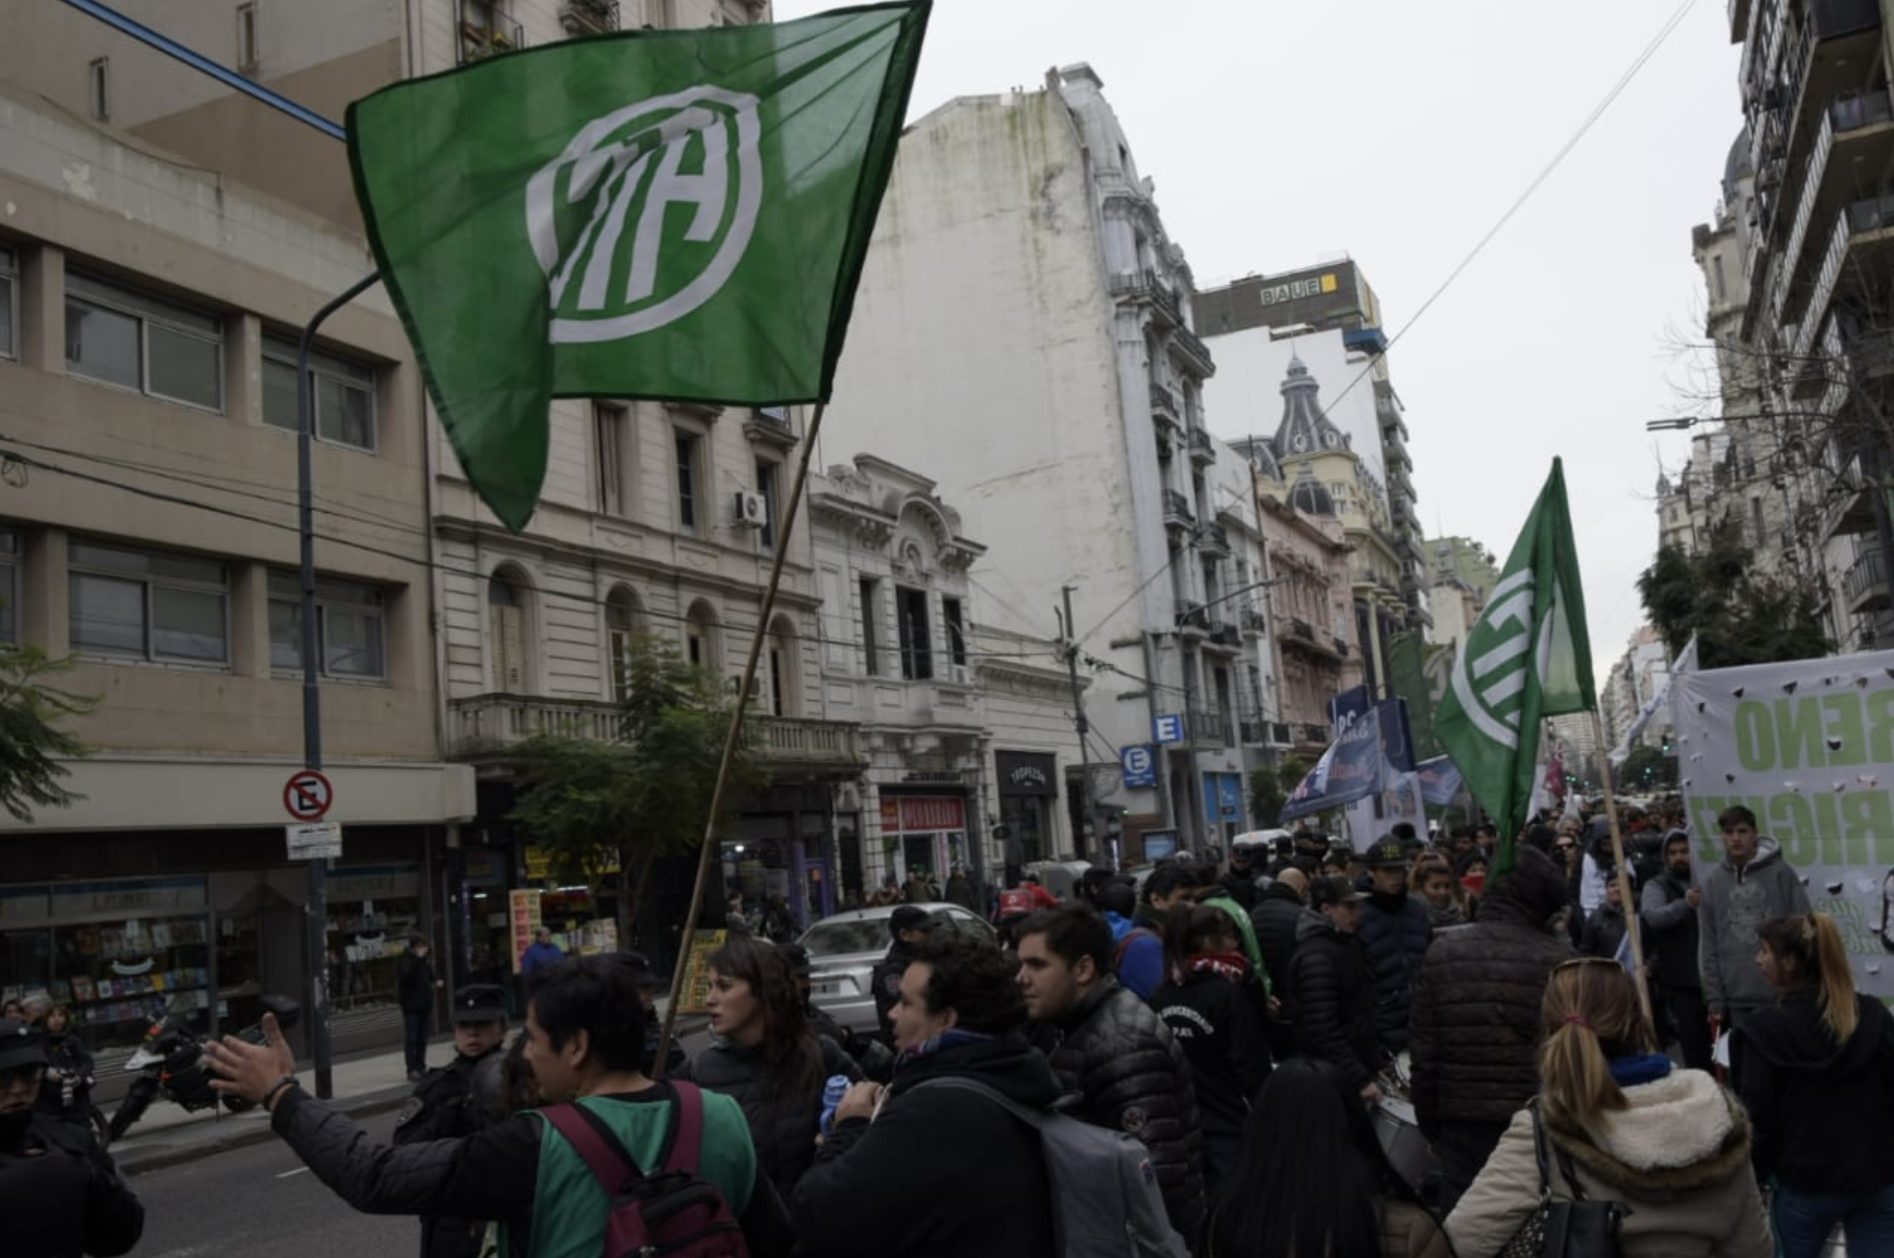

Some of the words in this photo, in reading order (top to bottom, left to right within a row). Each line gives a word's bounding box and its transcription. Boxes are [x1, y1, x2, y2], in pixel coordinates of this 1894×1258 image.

[1157, 717, 1176, 740] E
[1130, 751, 1145, 770] E
[298, 781, 319, 811] E
